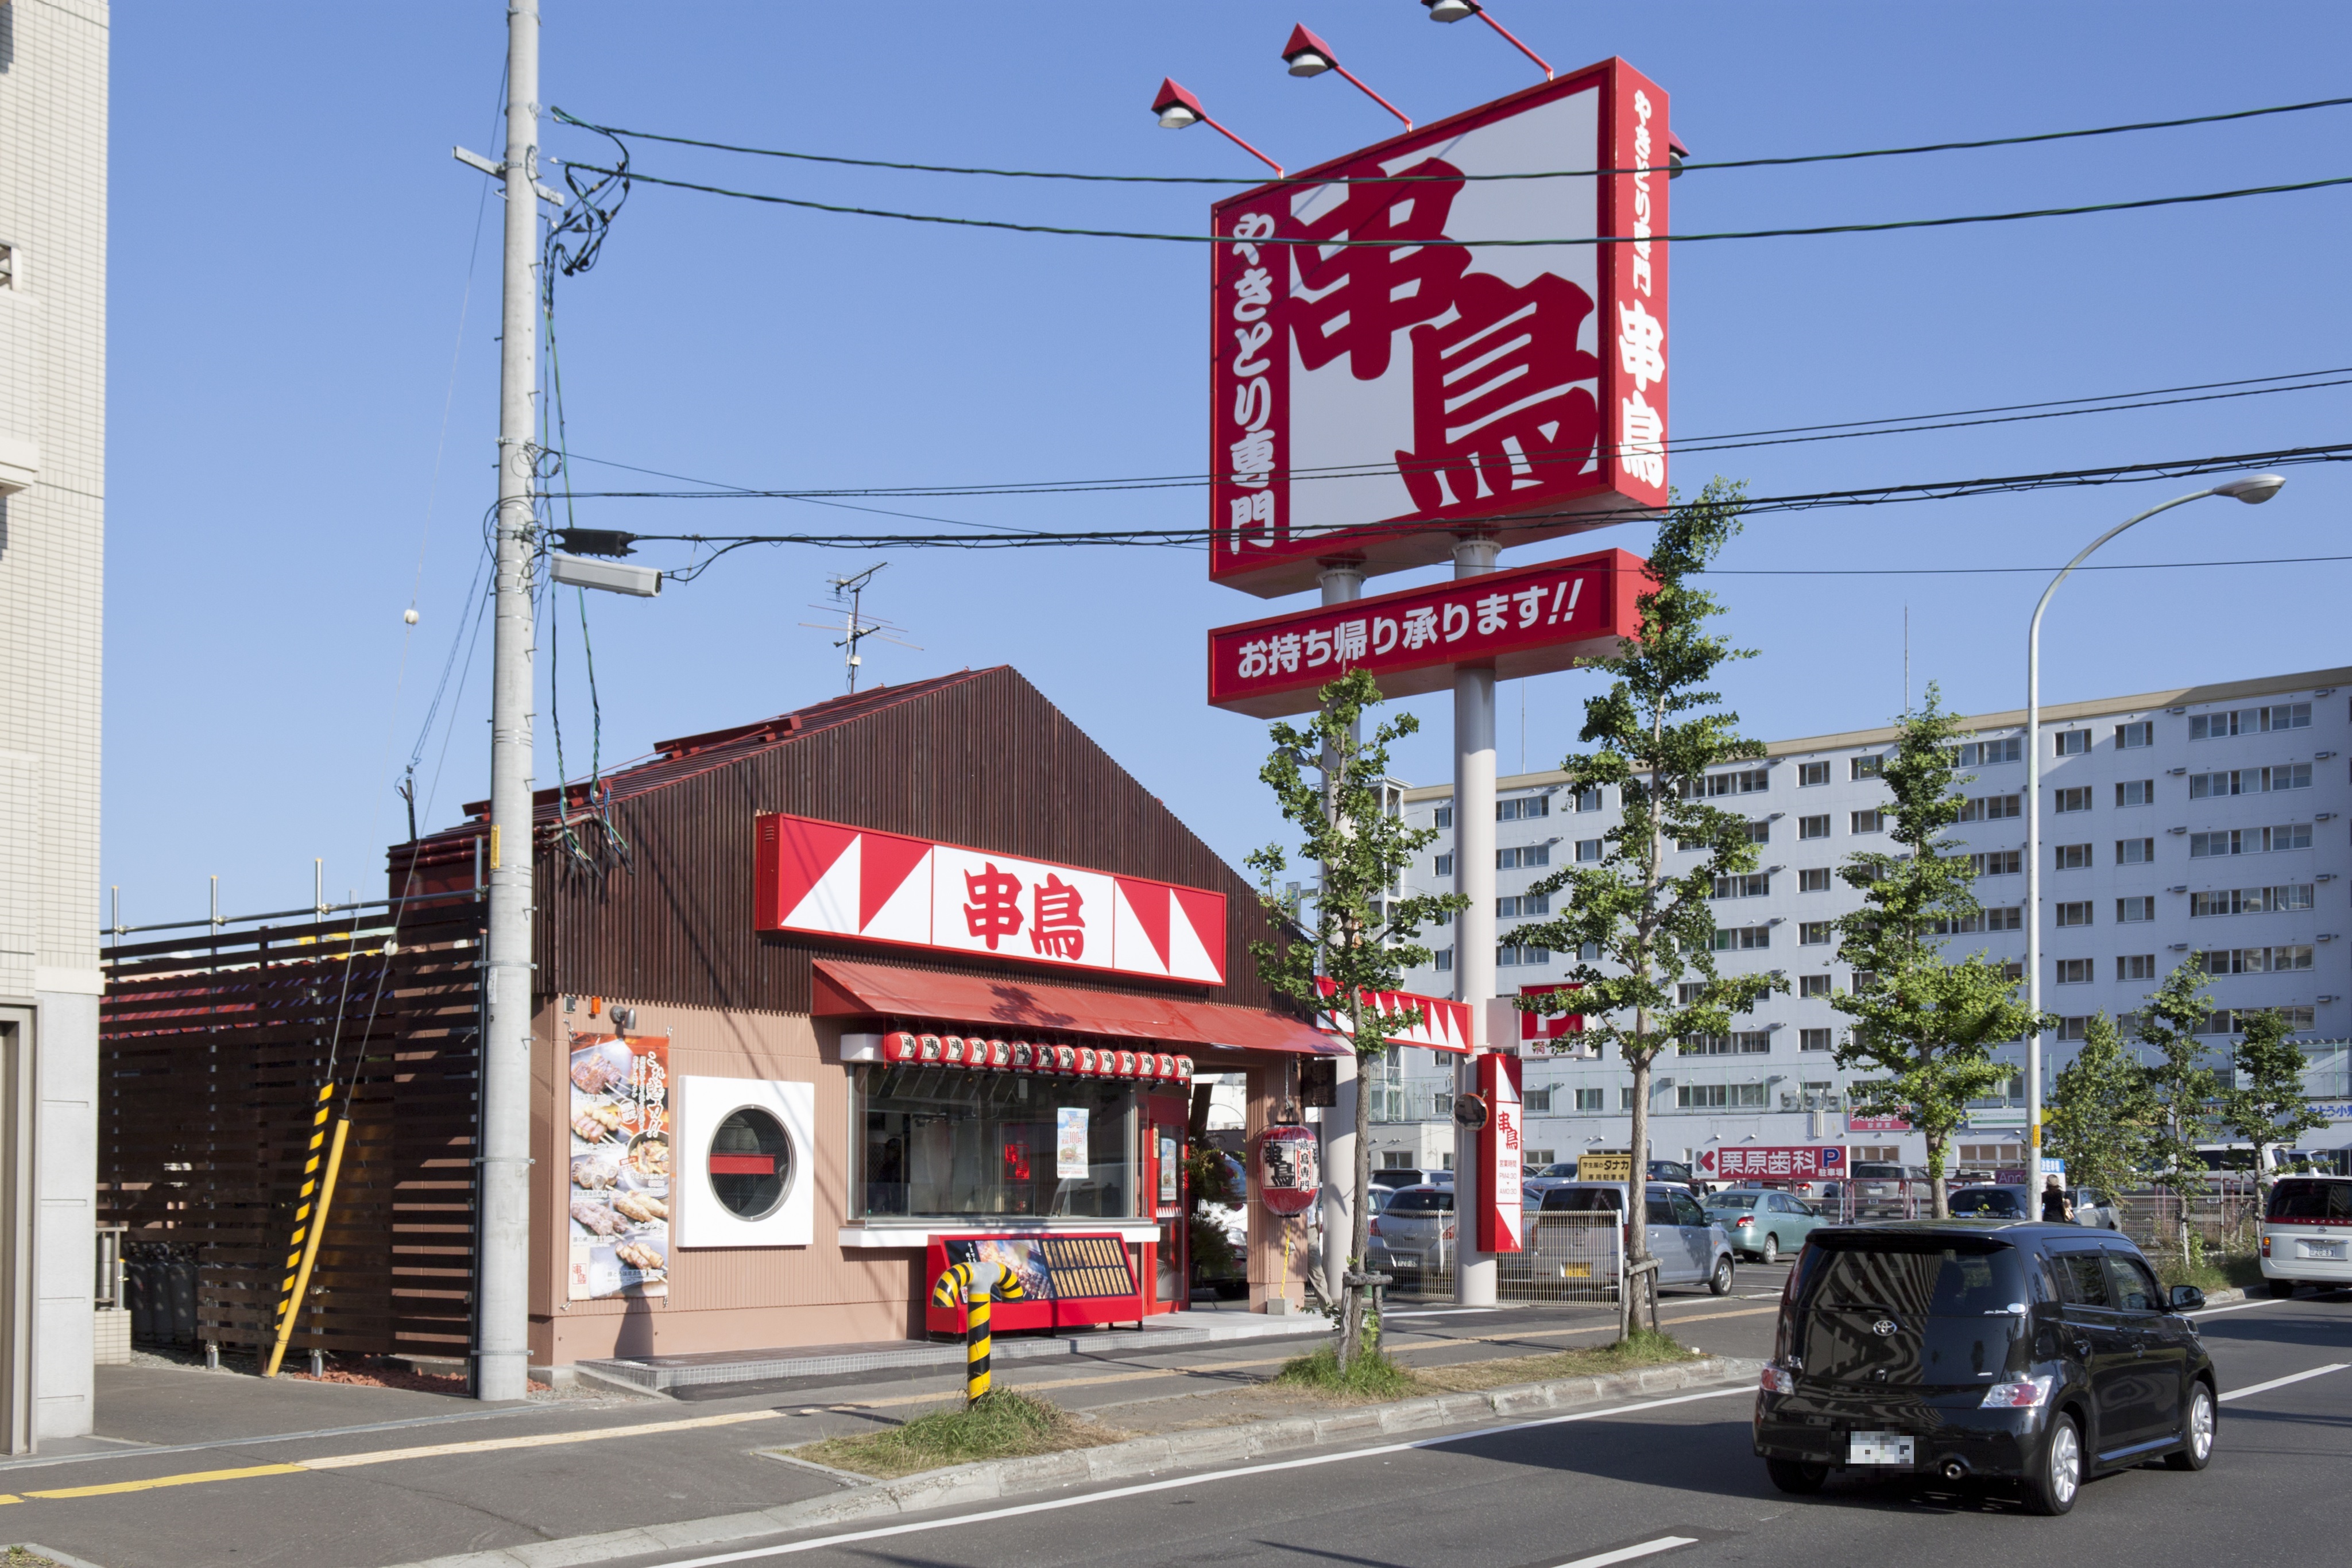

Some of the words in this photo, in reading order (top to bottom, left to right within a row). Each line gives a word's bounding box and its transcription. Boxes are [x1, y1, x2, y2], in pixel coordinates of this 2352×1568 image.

[1288, 157, 1599, 513] 串鳥
[1230, 213, 1275, 555] やきとり専門
[1619, 299, 1665, 489] 串鳥
[963, 861, 1085, 961] 串鳥
[1498, 1110, 1518, 1150] 串鳥
[1264, 1141, 1295, 1186] 串鳥
[1583, 1160, 1628, 1170] 学生服のタナカ
[1722, 1151, 1816, 1174] 栗原歯科
[1818, 1168, 1844, 1176] 駐車場
[1822, 1148, 1840, 1168] P
[1998, 1172, 2026, 1184] Ann
